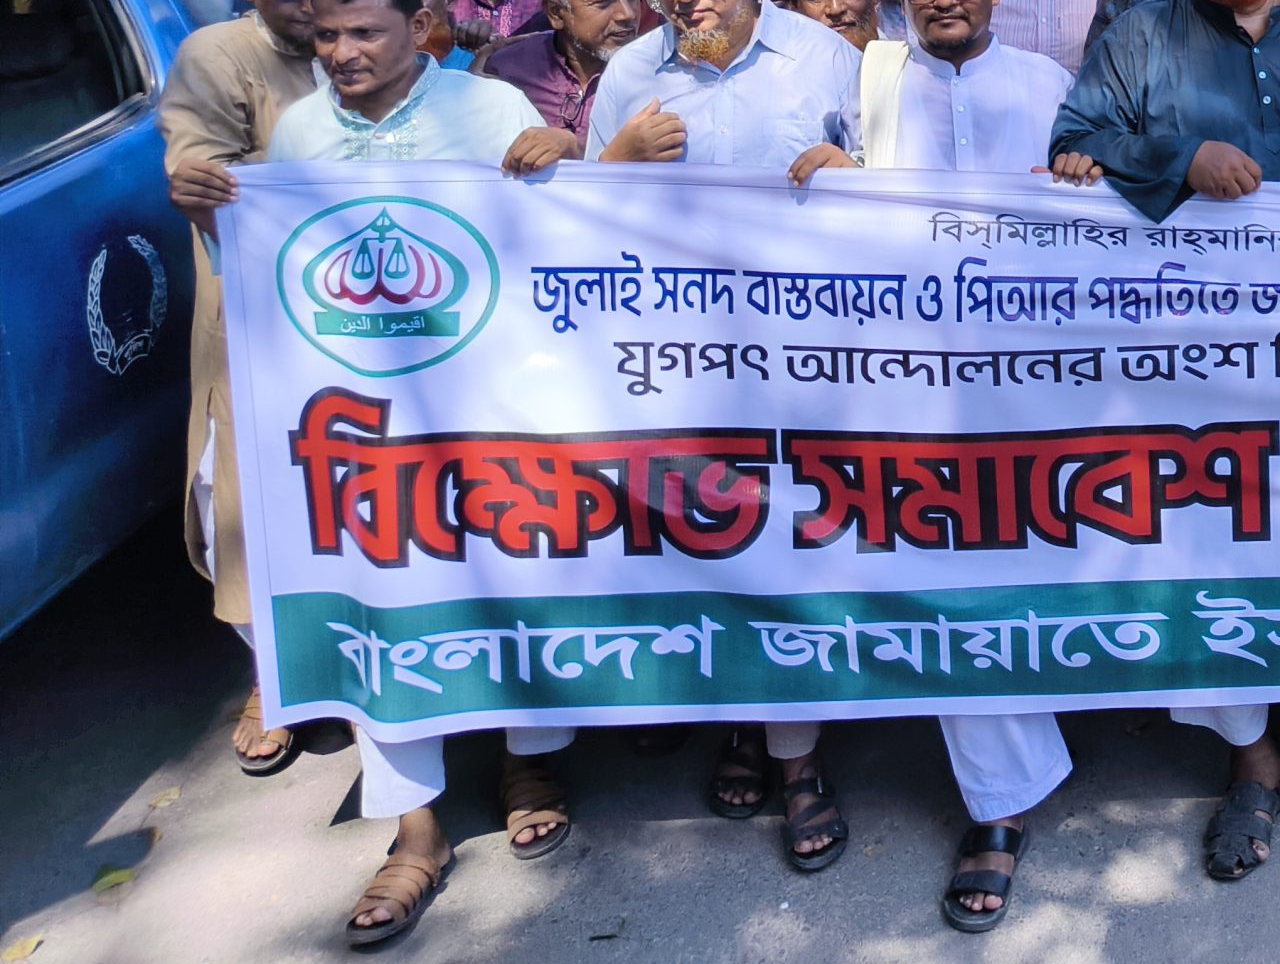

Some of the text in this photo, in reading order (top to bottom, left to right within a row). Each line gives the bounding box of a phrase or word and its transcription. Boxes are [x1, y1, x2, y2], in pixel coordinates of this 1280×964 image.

[531, 252, 643, 333] জুলাই
[652, 266, 736, 314] সনদ
[744, 269, 907, 327] বাস্তবায়ন
[915, 274, 943, 322] ও
[955, 257, 1079, 327] পিআর
[1088, 263, 1242, 324] পদ্ধতিতে
[613, 340, 770, 396] যুগপৎ
[784, 344, 1105, 388] আন্দোলনের
[1117, 340, 1258, 382] অংশ
[288, 386, 777, 569] বিক্ষোভ
[781, 424, 1280, 555] সমাবেশ
[327, 614, 727, 696] বাংলাদেশ
[747, 612, 1169, 679] জামায়াতে
